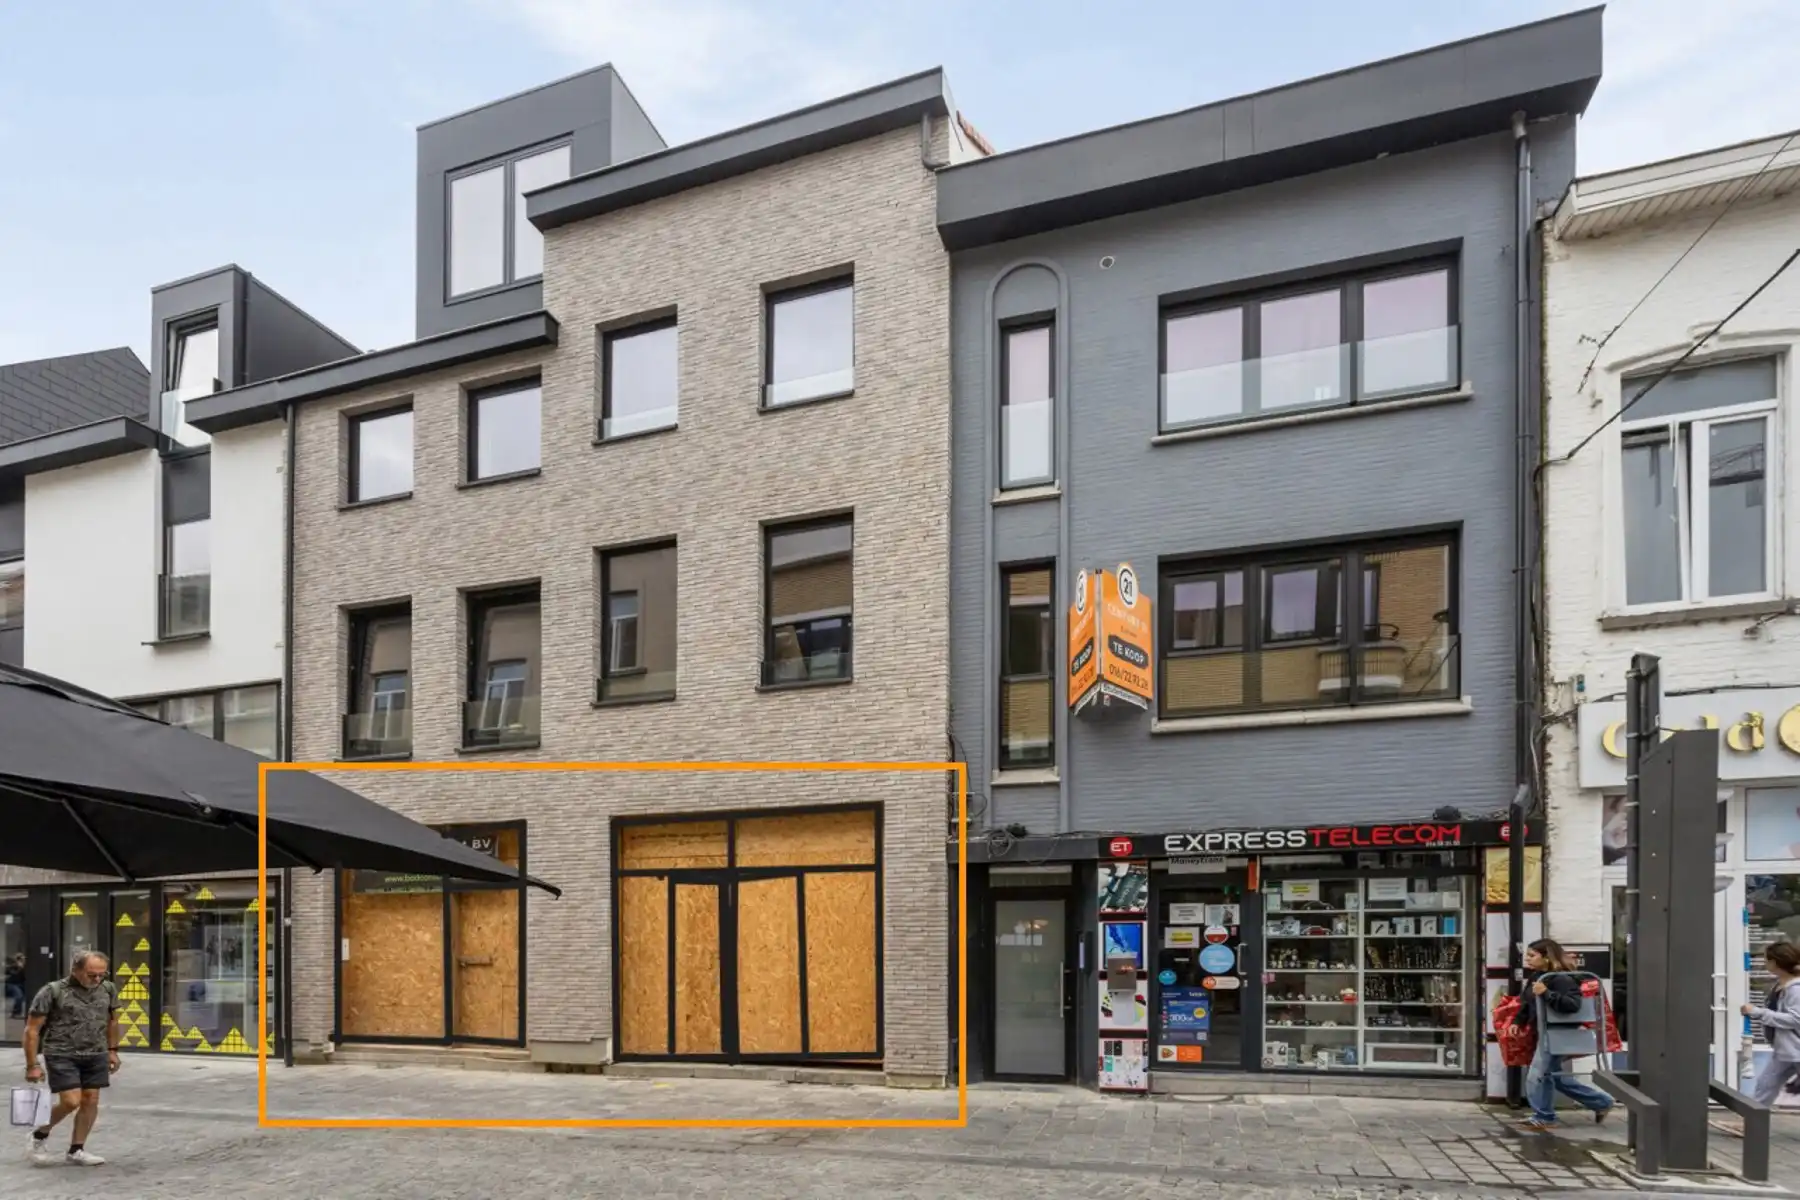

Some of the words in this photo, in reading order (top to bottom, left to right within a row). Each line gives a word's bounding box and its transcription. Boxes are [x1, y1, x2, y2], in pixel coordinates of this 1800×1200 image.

[1112, 640, 1123, 655] TE
[471, 838, 491, 849] BV
[1110, 841, 1130, 852] ET
